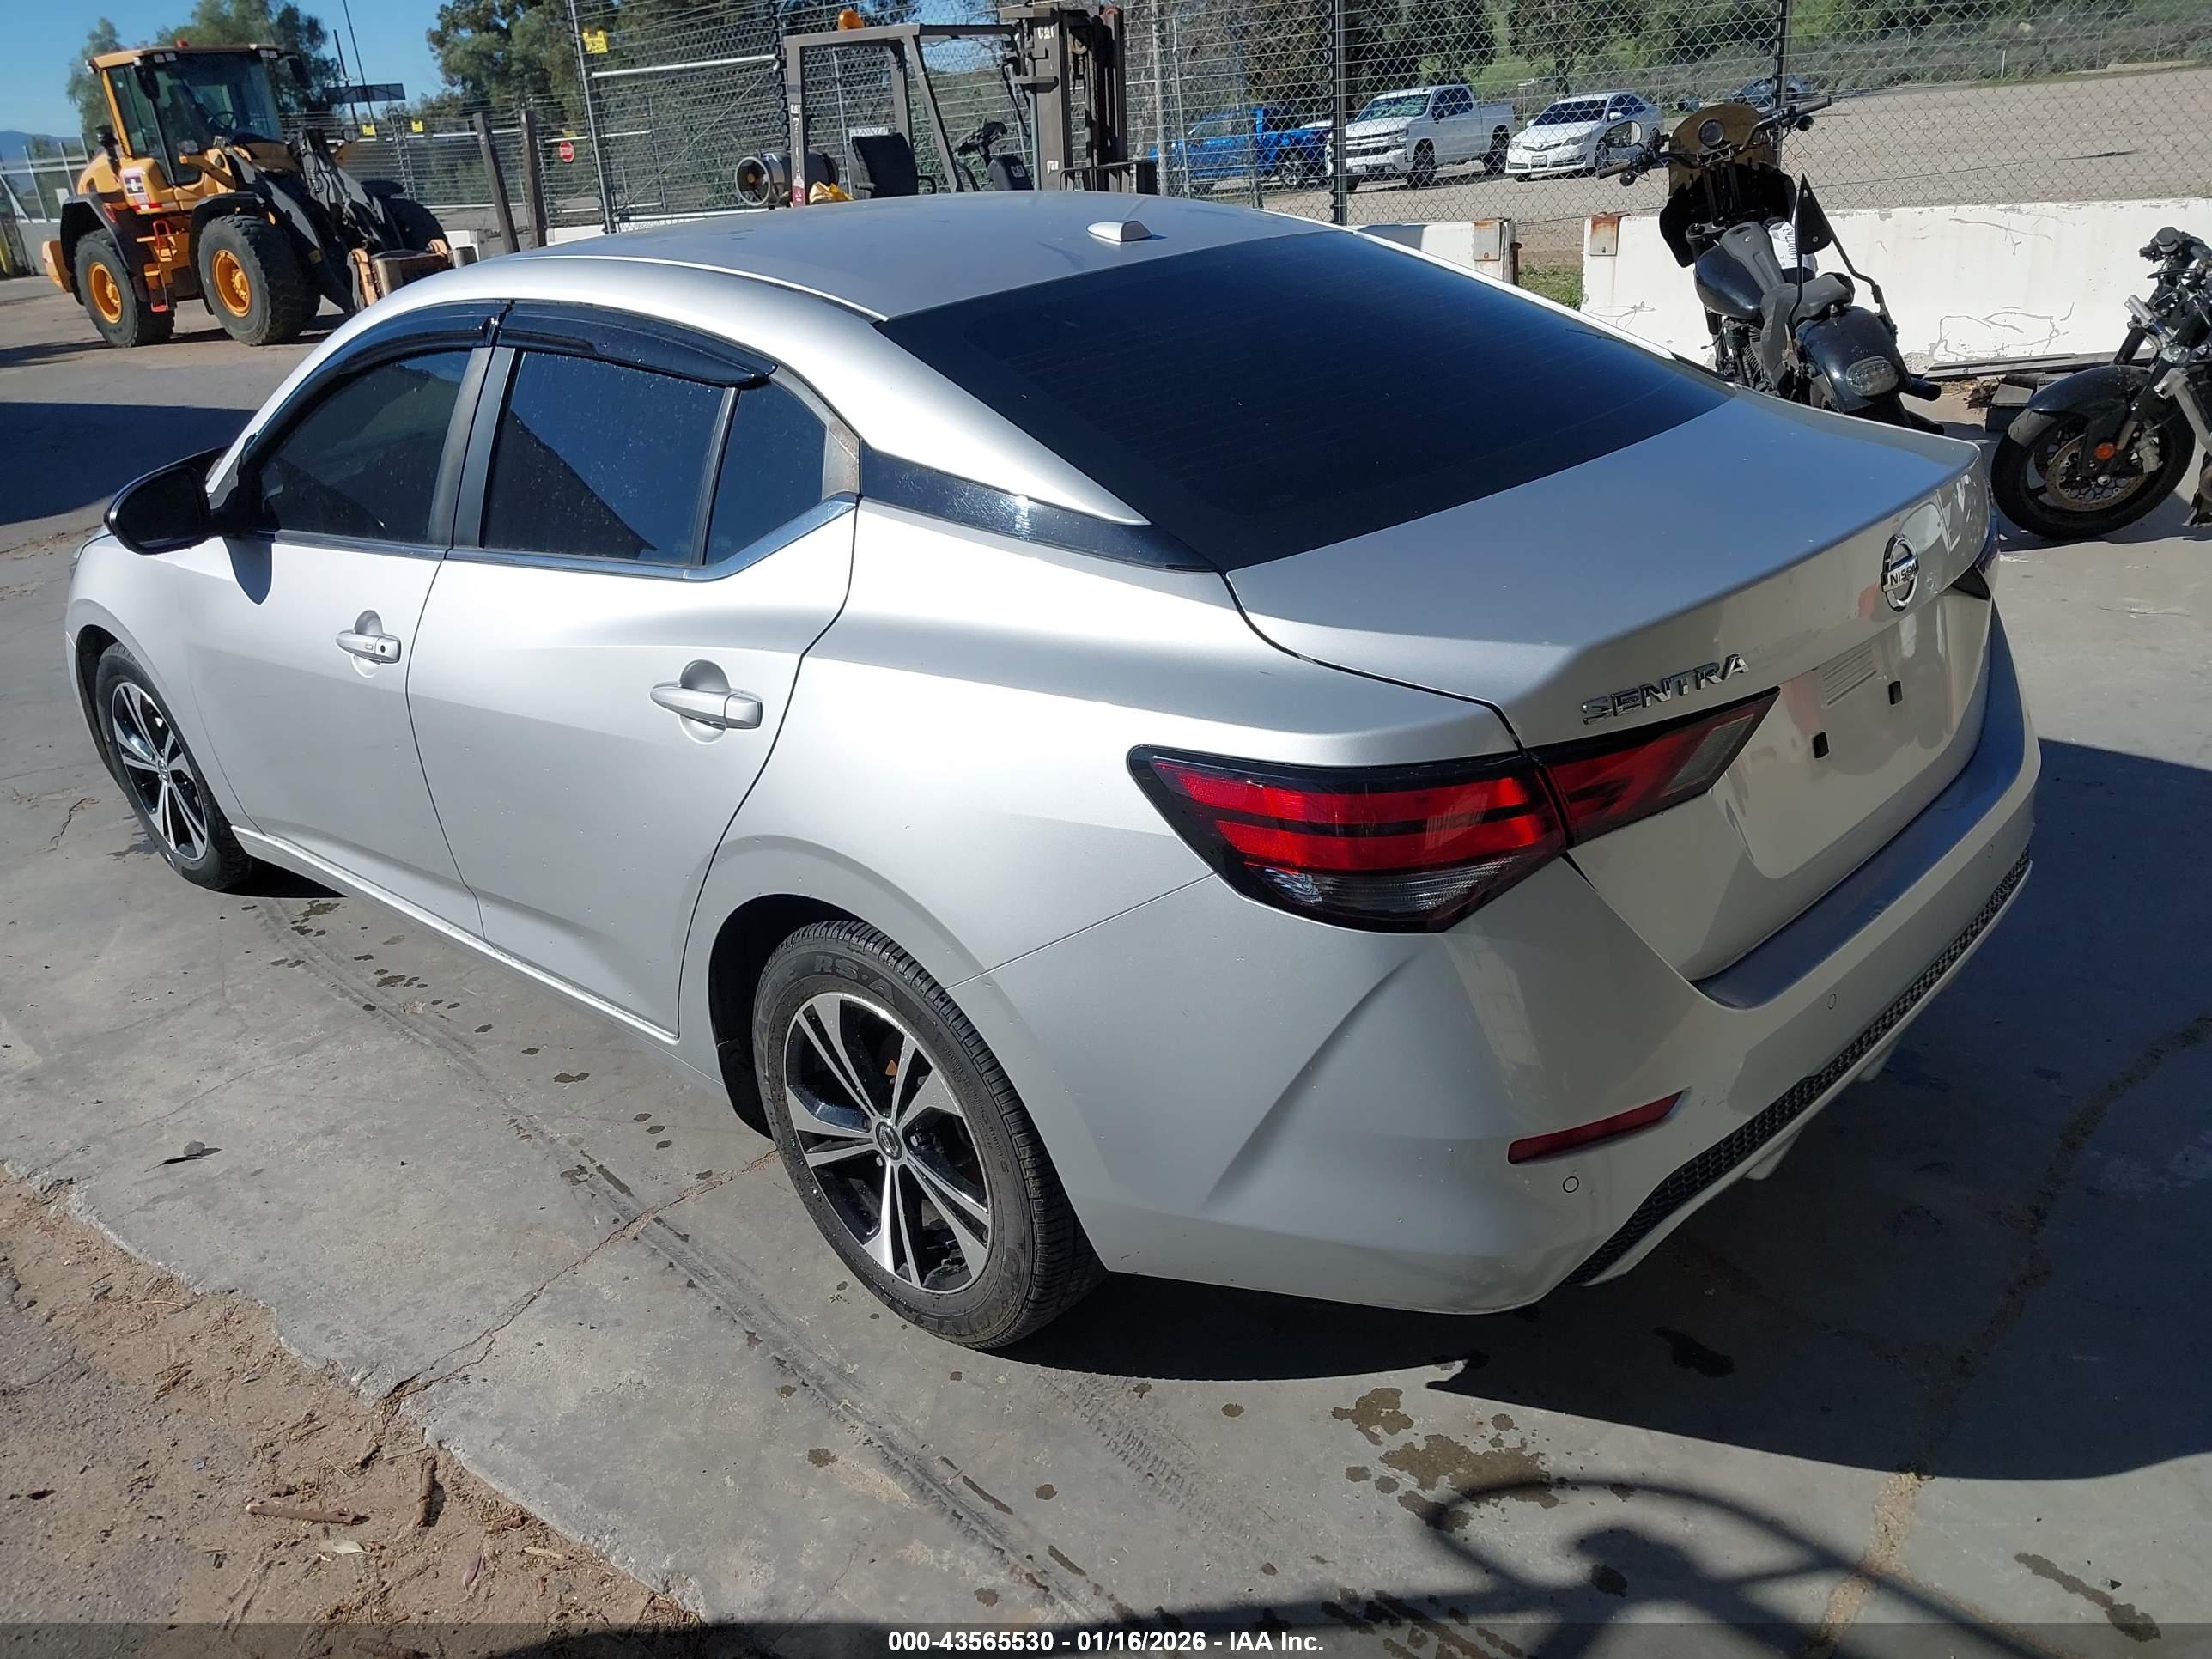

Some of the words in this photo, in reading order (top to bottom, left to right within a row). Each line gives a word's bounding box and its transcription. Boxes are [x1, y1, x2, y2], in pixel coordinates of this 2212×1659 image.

[1037, 27, 1054, 40] CAT
[1890, 562, 1917, 586] NISSA
[1582, 653, 1750, 725] SENTRA
